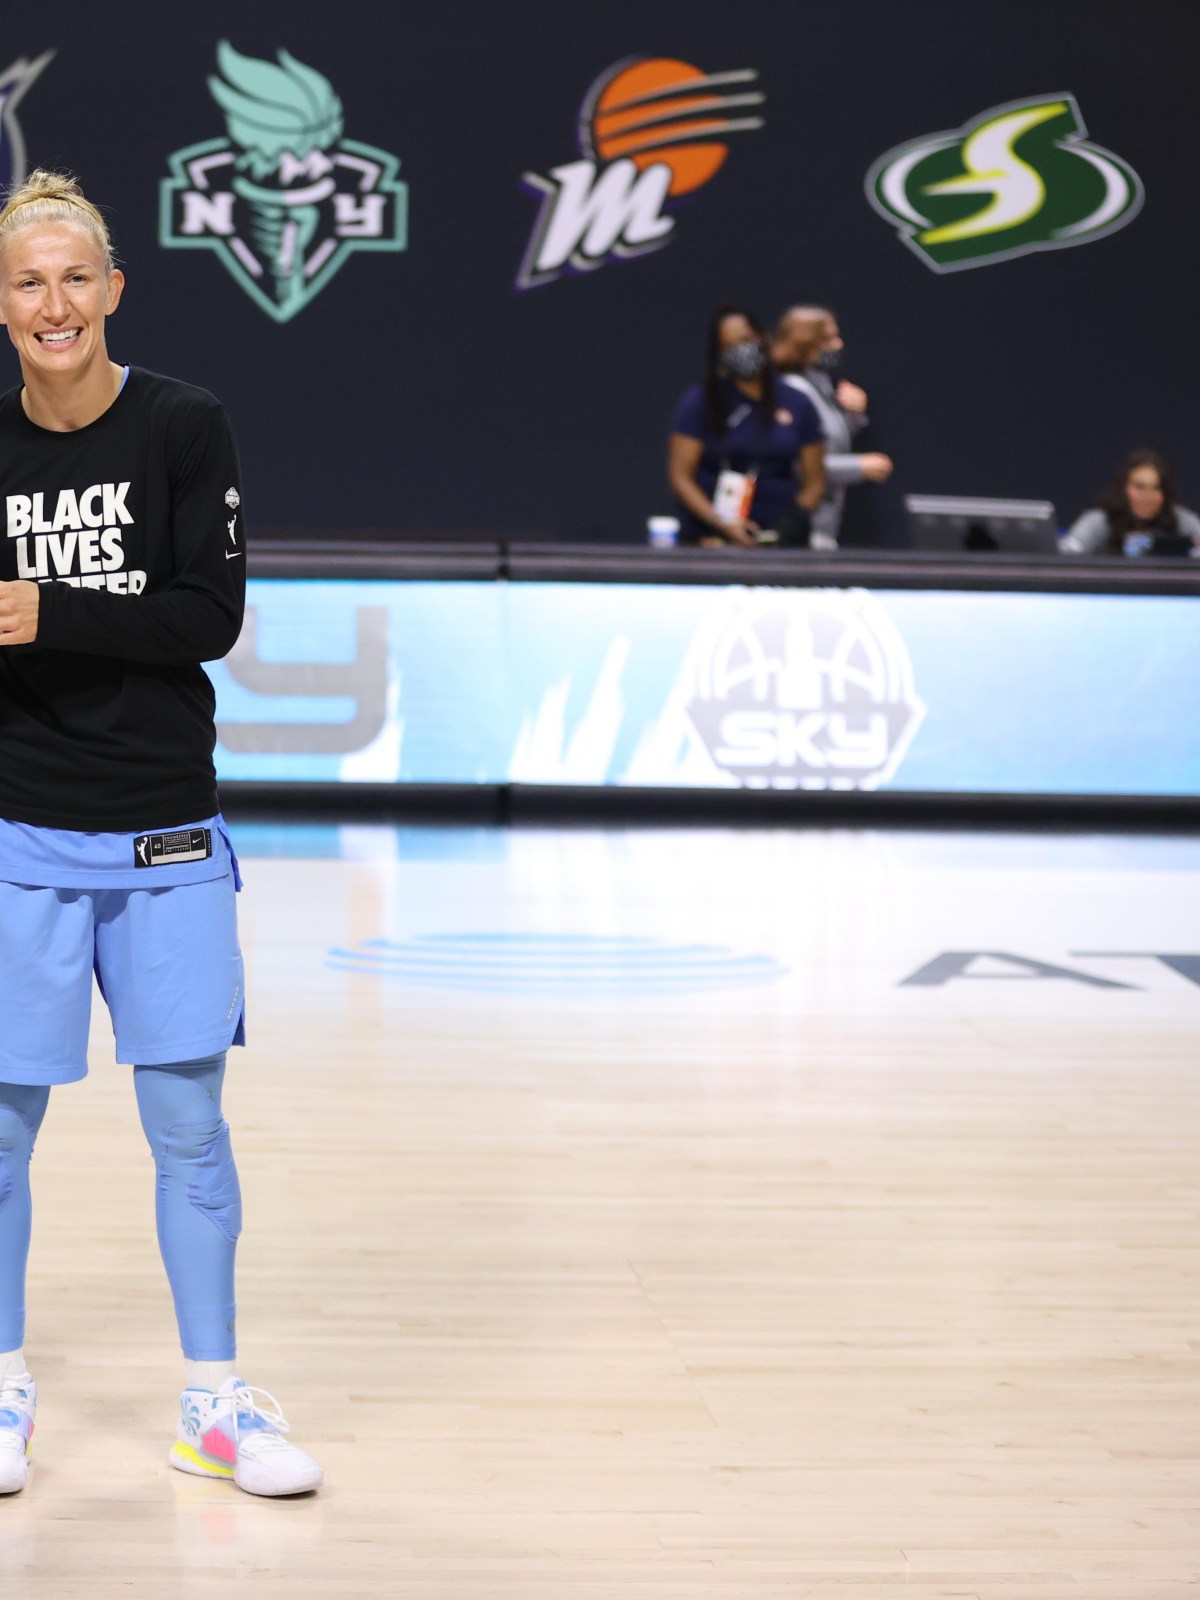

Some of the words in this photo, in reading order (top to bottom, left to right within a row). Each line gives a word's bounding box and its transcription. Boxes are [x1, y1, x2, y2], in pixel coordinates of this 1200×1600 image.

[6, 482, 135, 538] BLACK
[16, 527, 125, 579] LIVES
[715, 709, 889, 769] SKY
